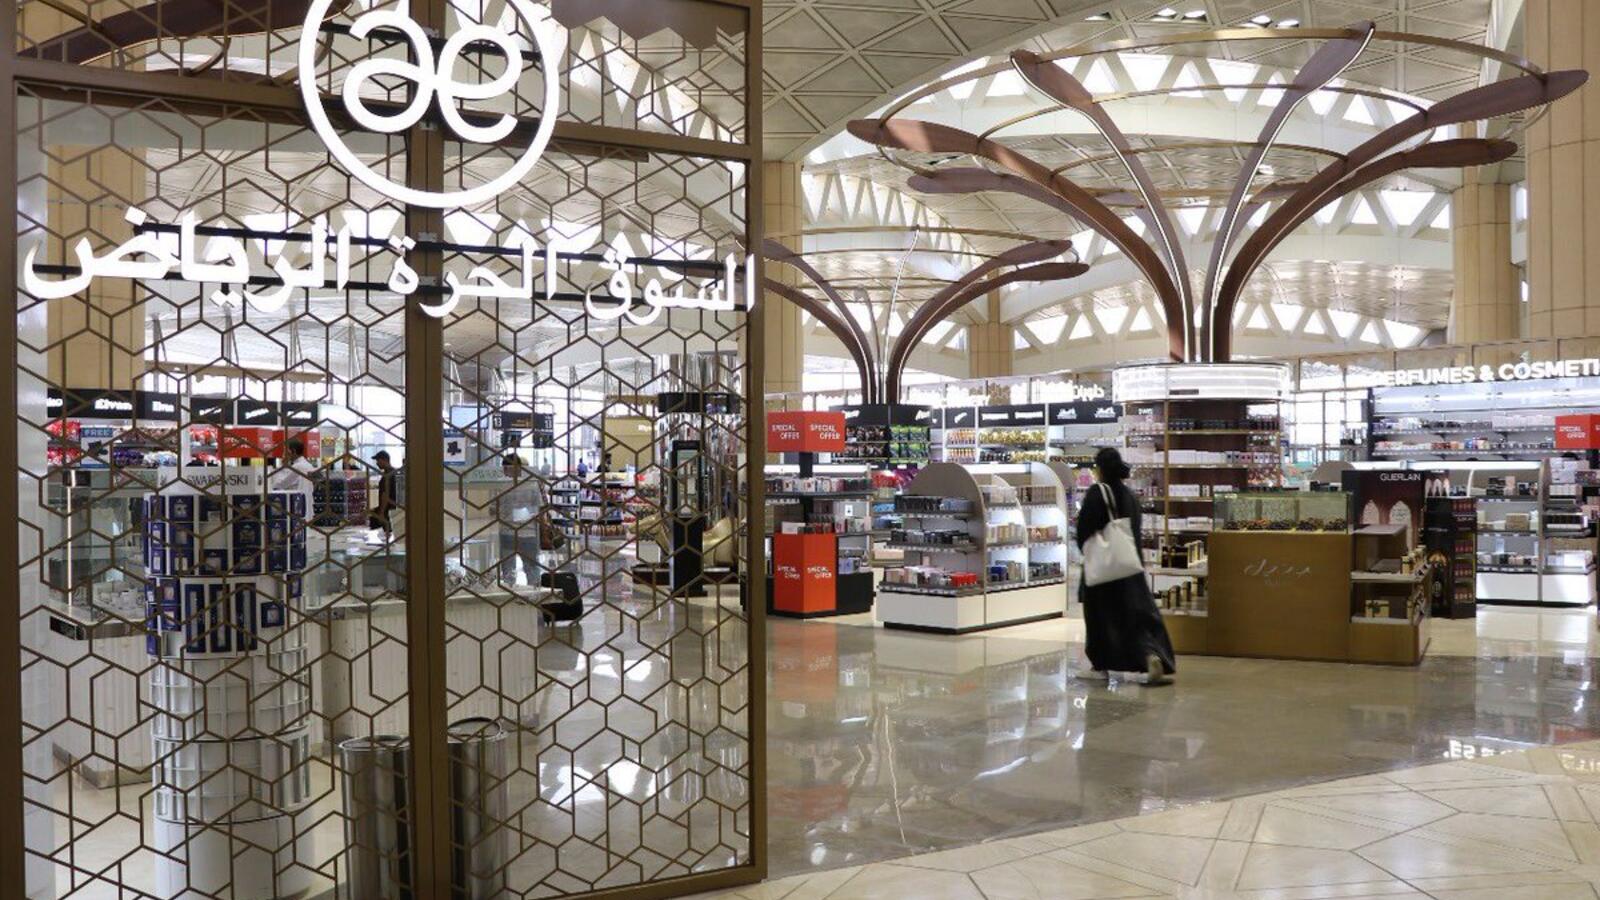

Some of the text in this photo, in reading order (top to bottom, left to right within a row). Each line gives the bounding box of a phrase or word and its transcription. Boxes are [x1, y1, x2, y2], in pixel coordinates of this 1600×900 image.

[23, 206, 755, 326] السوق الحرة الرياض
[1371, 366, 1475, 387] PERFUMES
[1479, 364, 1495, 382] &
[819, 432, 841, 440] OFFER
[1379, 472, 1421, 481] GUERLAIN
